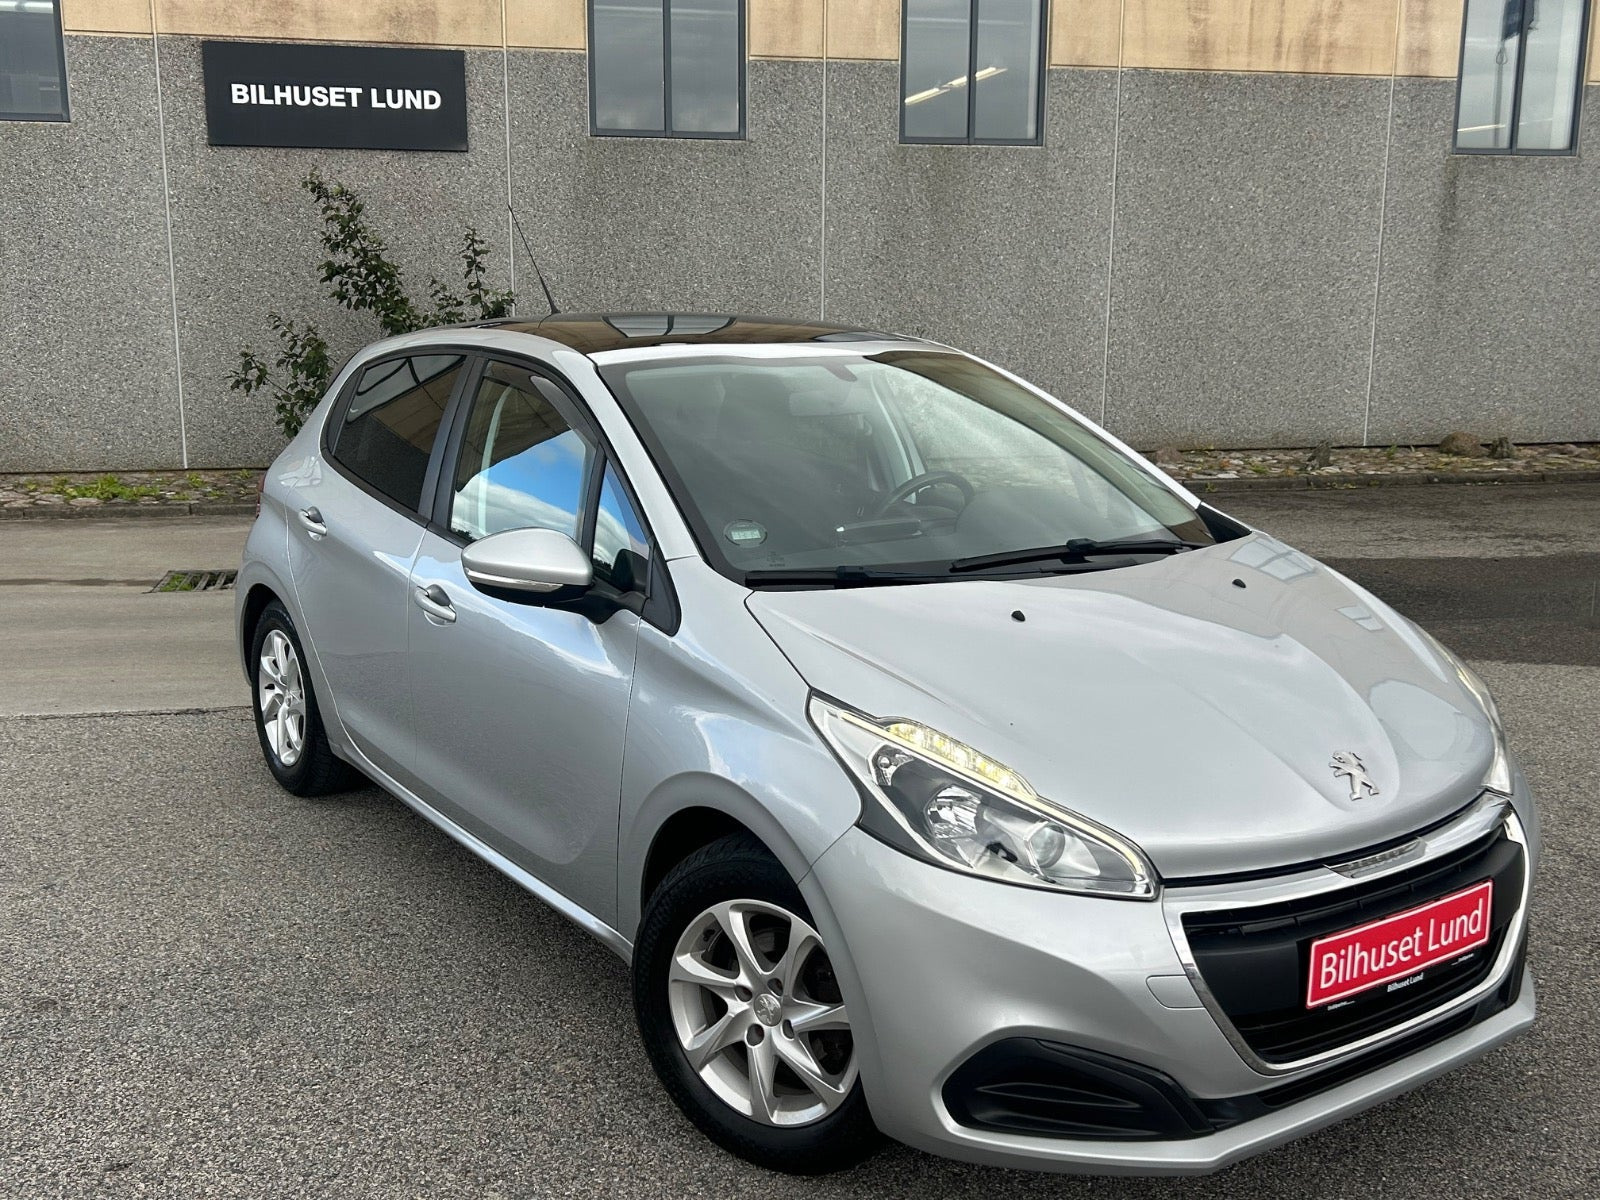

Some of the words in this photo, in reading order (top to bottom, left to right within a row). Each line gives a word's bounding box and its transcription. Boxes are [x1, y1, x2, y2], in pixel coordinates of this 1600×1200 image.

[231, 84, 362, 107] BILHUSET
[371, 88, 442, 110] LUND
[1320, 927, 1423, 989] Bilhuset
[1428, 898, 1483, 952] Lund
